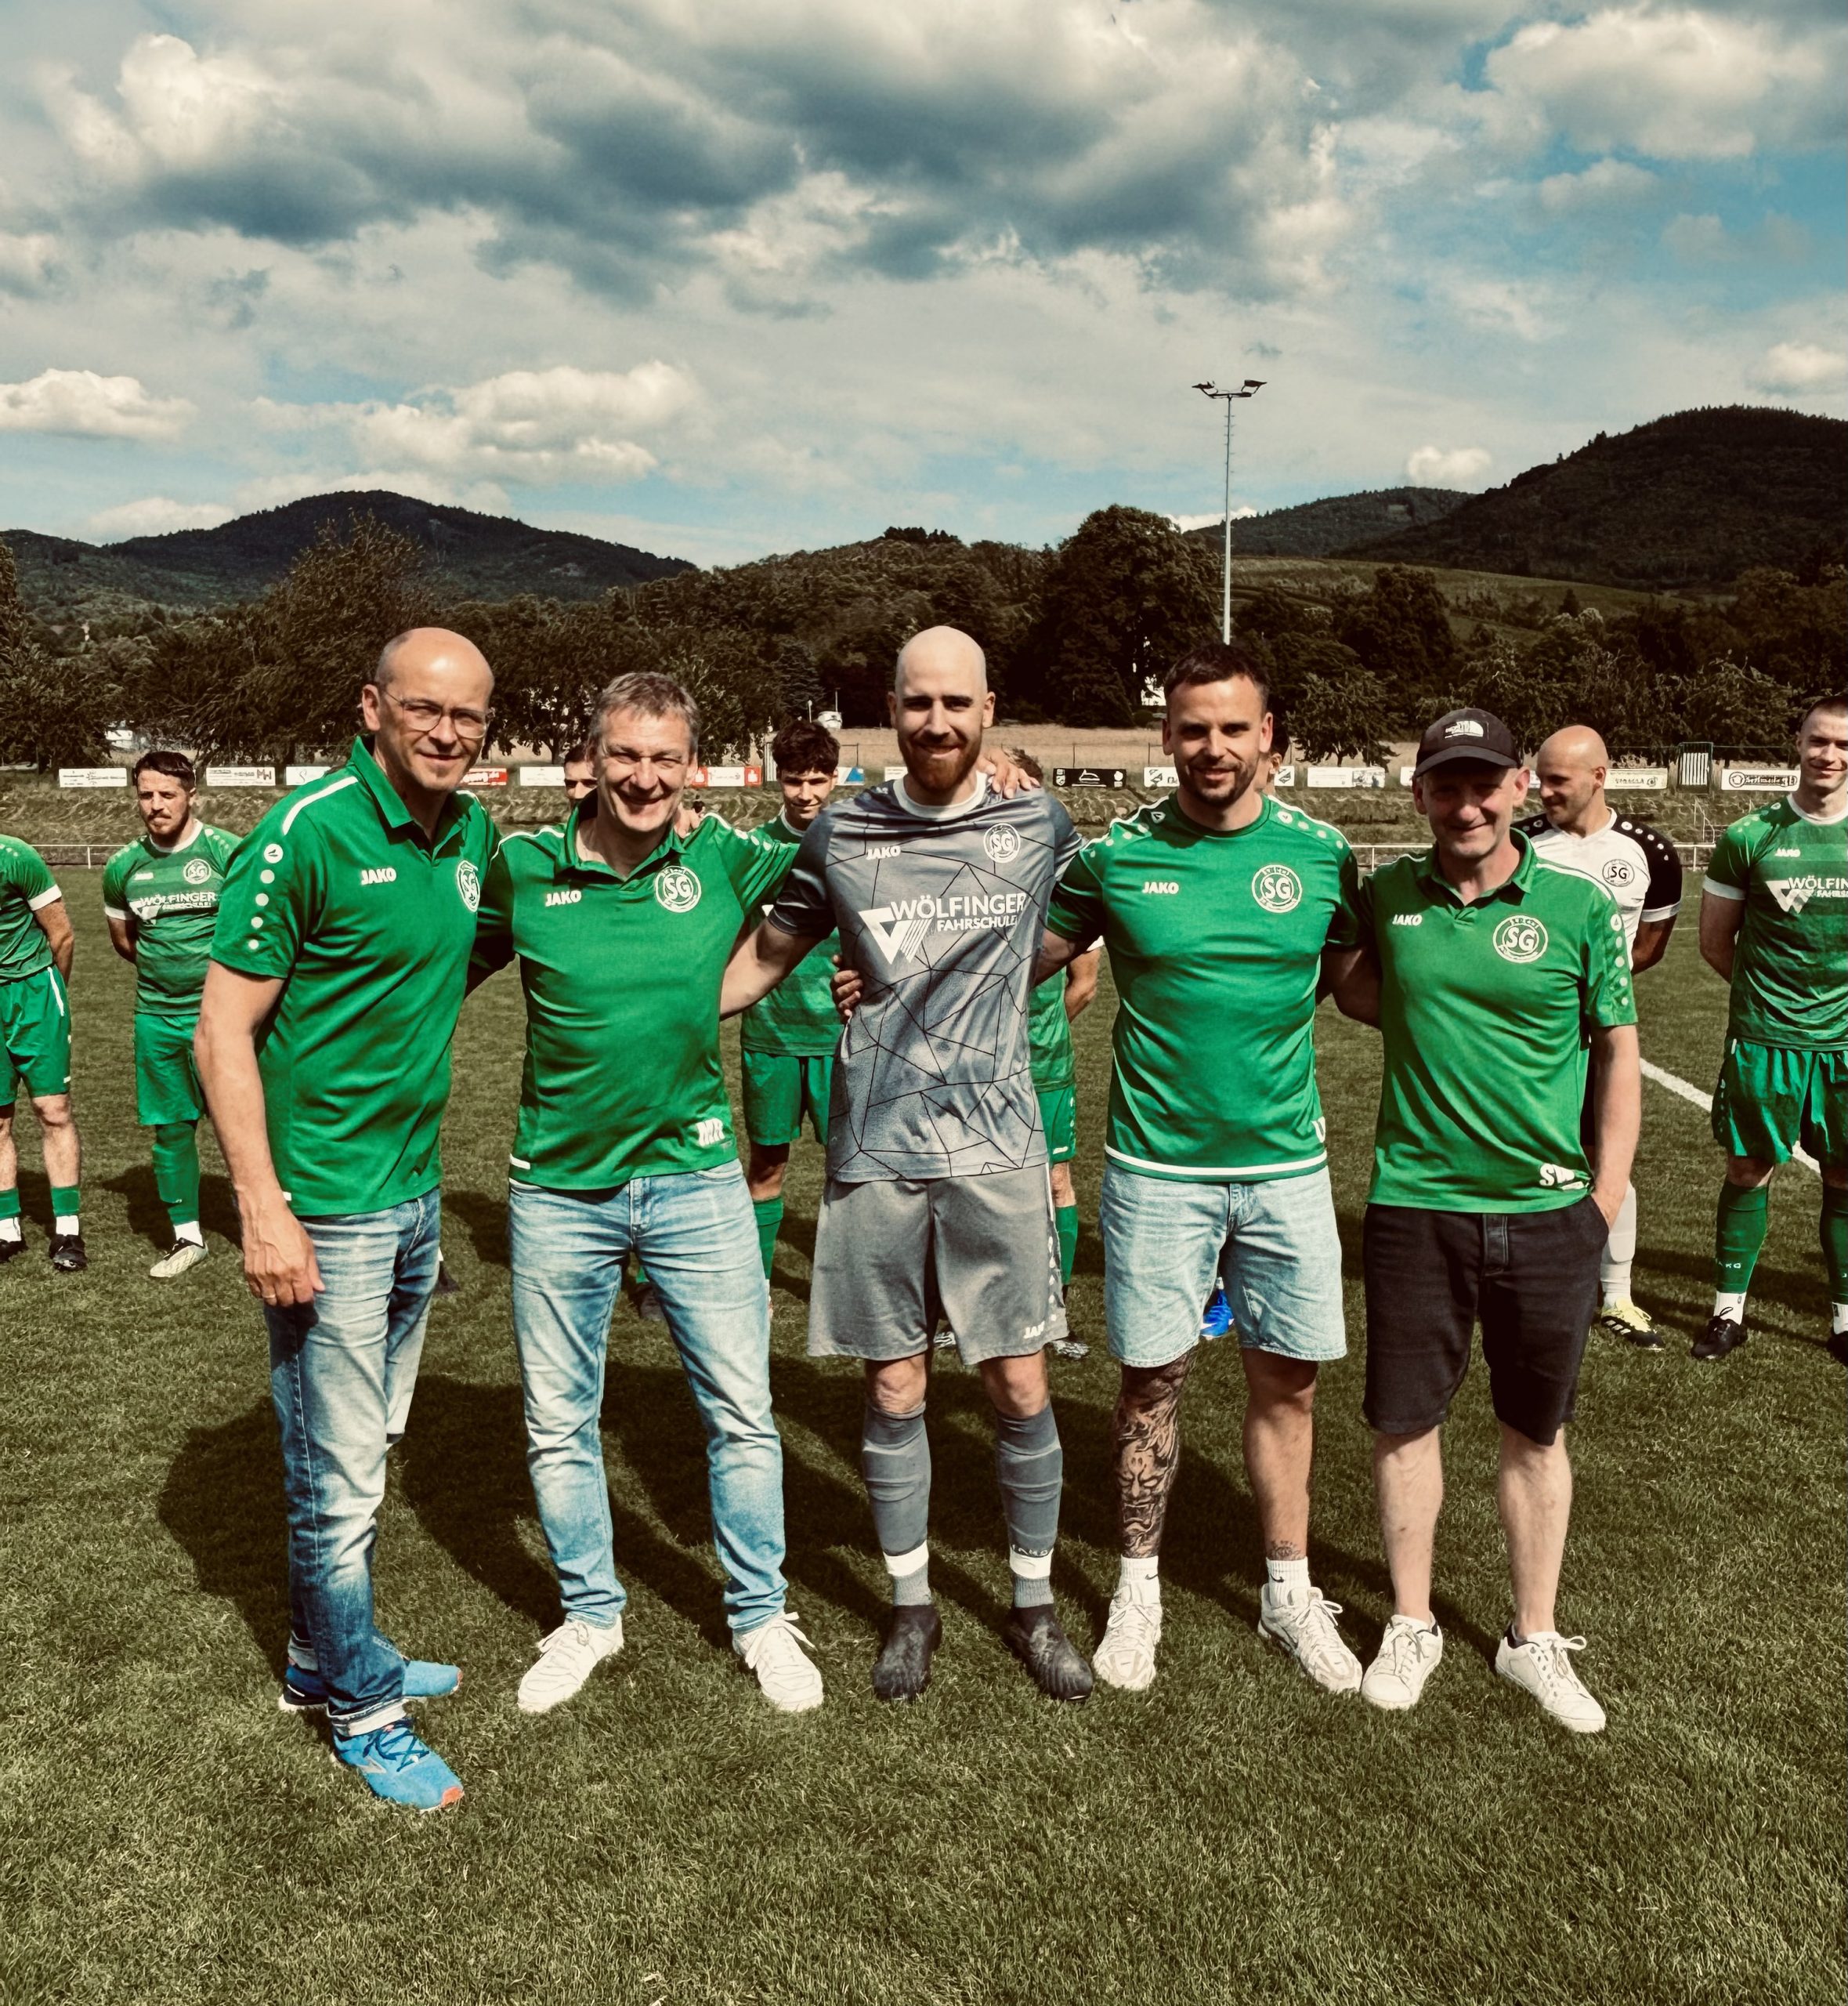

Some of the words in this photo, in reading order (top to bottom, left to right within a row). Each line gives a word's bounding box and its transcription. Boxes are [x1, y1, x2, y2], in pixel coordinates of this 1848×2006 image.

[866, 845, 901, 860] JAKO
[361, 867, 397, 885] JAKO
[1610, 866, 1629, 879] SG
[664, 875, 692, 900] SG
[1141, 882, 1180, 894] JAKO
[1264, 877, 1291, 900] SG
[544, 890, 582, 907] JAKO
[891, 893, 1027, 921] WÖLFINGER
[937, 915, 1018, 932] FAHRSCHULE
[1392, 914, 1423, 926] JAKO
[1506, 926, 1535, 951] SG
